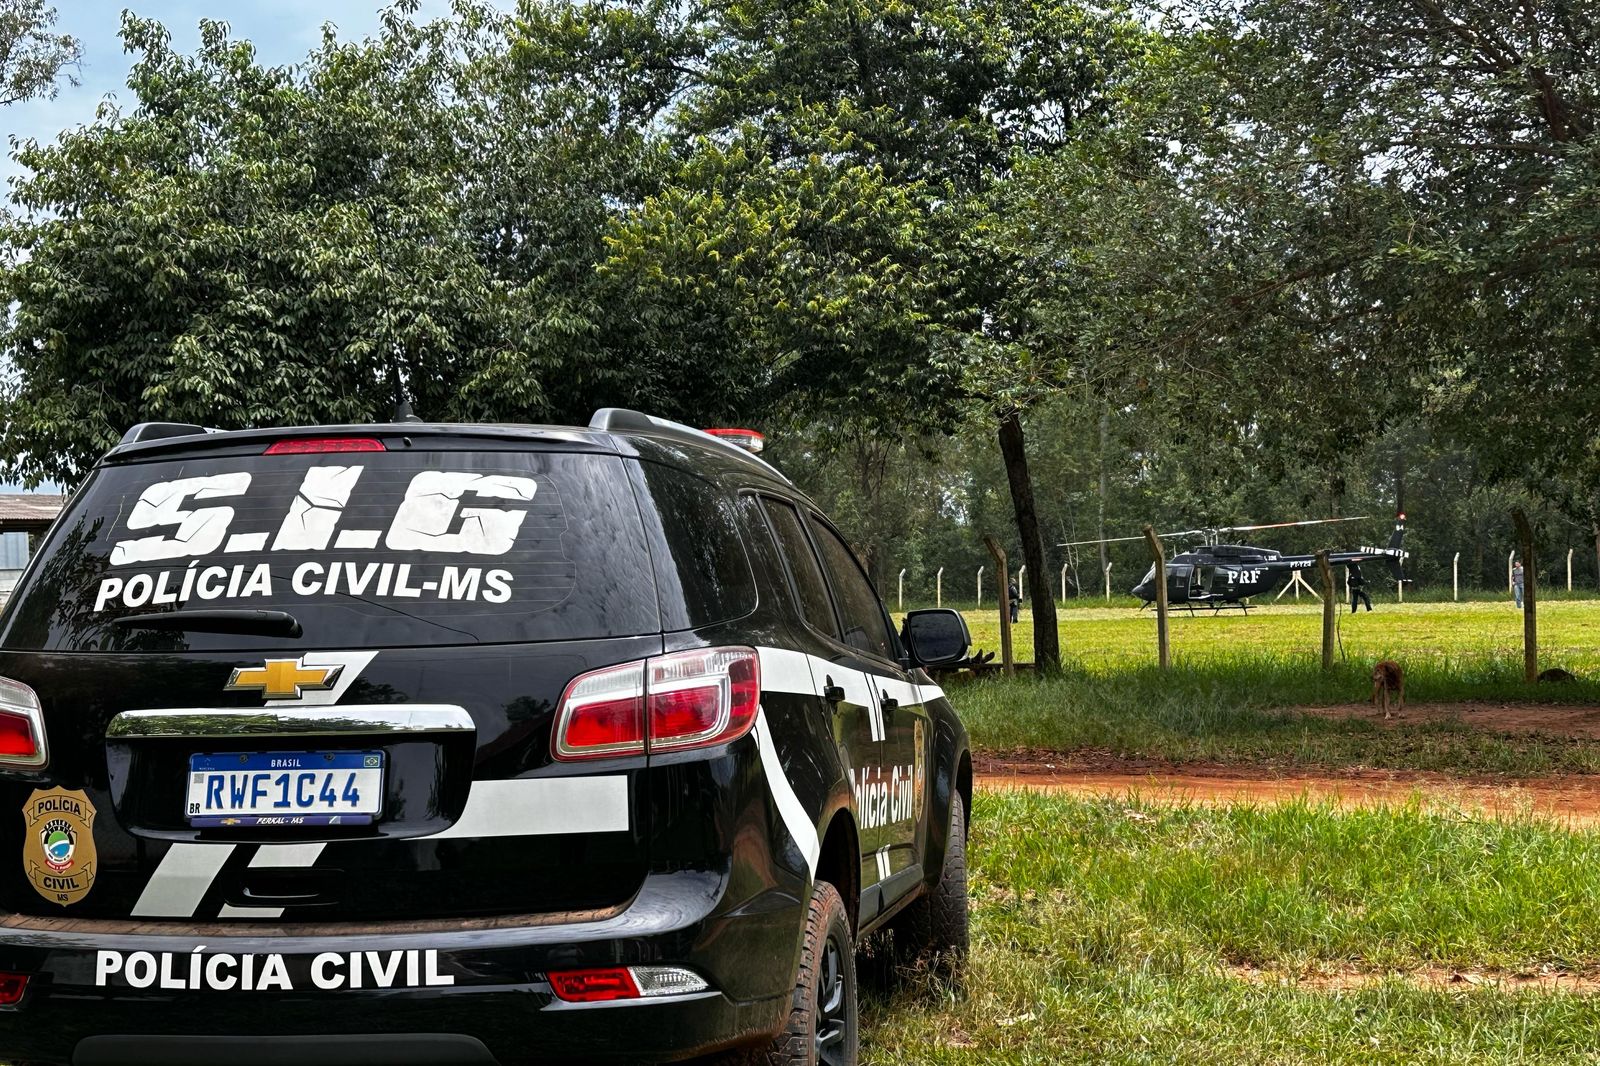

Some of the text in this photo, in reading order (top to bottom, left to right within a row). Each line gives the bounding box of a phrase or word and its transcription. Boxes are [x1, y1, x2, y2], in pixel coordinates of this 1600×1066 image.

[1227, 569, 1261, 584] PRF
[93, 560, 514, 612] POLÍCIA CIVIL-MS
[271, 758, 301, 768] BRASIL
[205, 772, 360, 810] RWF1C44
[891, 764, 913, 824] Civil
[38, 795, 81, 815] POLÍCIA
[189, 803, 200, 814] BR
[43, 877, 79, 890] CIVIL
[57, 894, 69, 902] MS
[95, 945, 455, 990] POLÍCIA CIVIL
